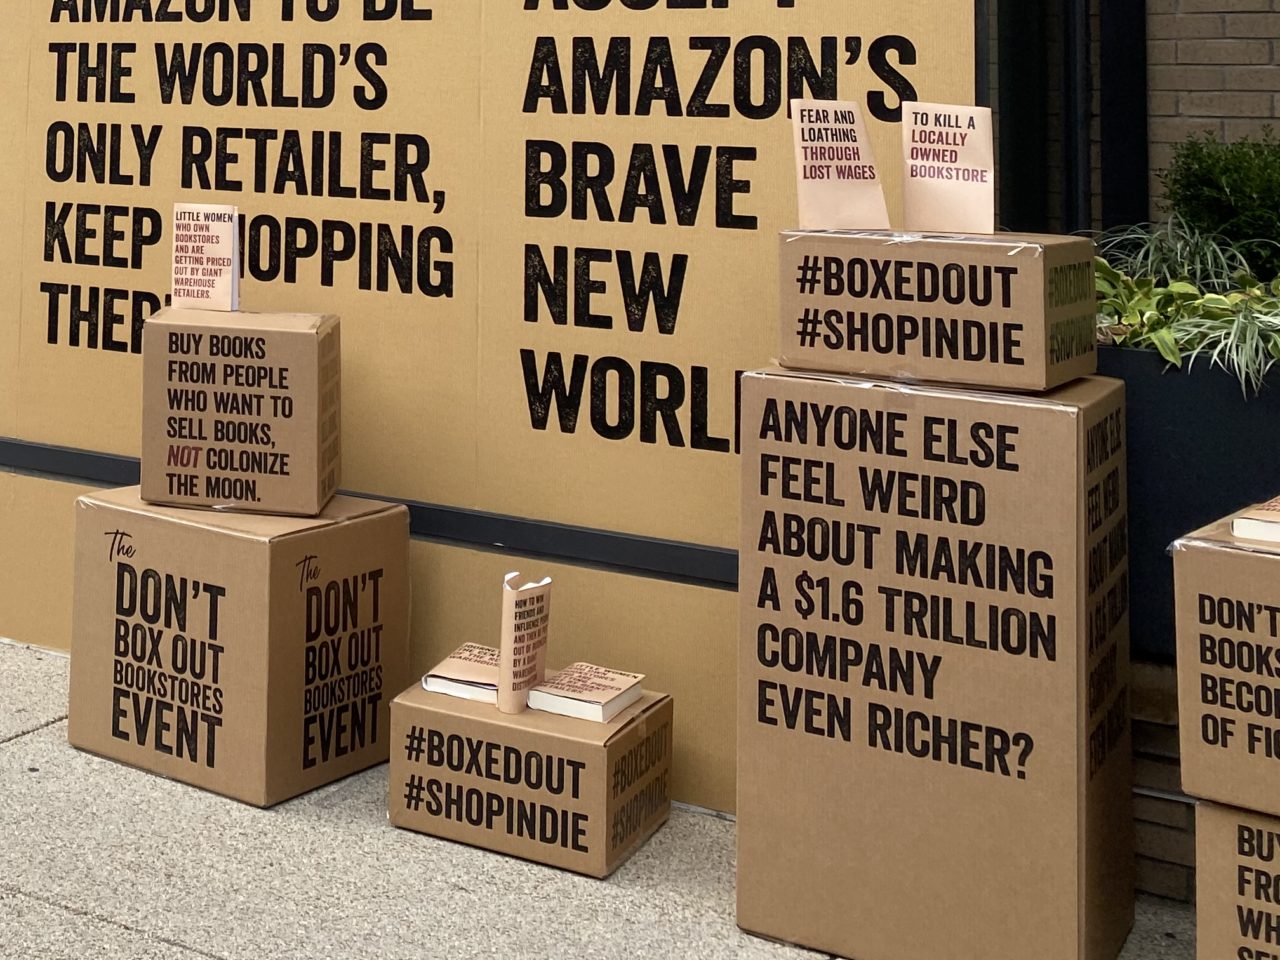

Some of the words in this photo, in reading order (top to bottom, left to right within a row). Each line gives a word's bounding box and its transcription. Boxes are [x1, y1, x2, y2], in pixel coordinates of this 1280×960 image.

[48, 42, 136, 103] THE
[154, 42, 388, 111] WORLD'S
[521, 34, 919, 123] AMAZON'S
[800, 108, 829, 124] FEAR
[833, 109, 855, 125] AND
[801, 126, 857, 143] LOATHING
[911, 111, 929, 127] TO
[933, 112, 962, 129] KILL
[966, 115, 975, 130] A
[911, 128, 968, 147] LOCALLY
[44, 120, 163, 187] ONLY
[180, 125, 446, 214] RETAILER,
[801, 145, 861, 162] THROUGH
[802, 164, 831, 180] LOST
[835, 164, 876, 181] WAGES
[909, 163, 988, 183] BOOKSTORE
[910, 146, 958, 164] OWNED
[524, 139, 759, 231] BRAVE
[43, 201, 162, 270] KEEP
[175, 211, 200, 222] LITTLE
[203, 212, 233, 223] WOMEN
[175, 222, 191, 232] WHO
[193, 223, 210, 232] OWN
[175, 233, 219, 244] BOOKSTORES
[174, 255, 204, 265] GETTING
[206, 257, 231, 267] PRICED
[174, 267, 188, 275] OUT
[190, 267, 199, 276] BY
[201, 267, 222, 277] GIANT
[175, 244, 189, 254] AND
[191, 245, 204, 254] ARE
[174, 277, 215, 288] WAREHOUSE
[523, 242, 689, 335] NEW
[758, 398, 908, 457] ANYONE
[923, 415, 1019, 472] ELSE
[759, 453, 845, 507] FEEL
[858, 465, 986, 527] WEIRD
[104, 529, 137, 562] The
[757, 510, 881, 569] ABOUT
[895, 529, 1054, 600] MAKING
[115, 560, 226, 641] DON'T
[756, 566, 780, 611] A
[793, 570, 864, 626] $1.6
[877, 585, 1057, 662] TRILLION
[114, 618, 163, 669] BOX
[171, 633, 224, 685] OUT
[756, 622, 942, 700] COMPANY
[113, 659, 224, 715] BOOKSTORES
[111, 685, 223, 769] EVENT
[757, 678, 852, 742] EVEN
[867, 701, 1035, 780] RICHER?
[404, 724, 586, 800] #BOXEDOUT
[404, 773, 589, 854] #SHOPINDIE
